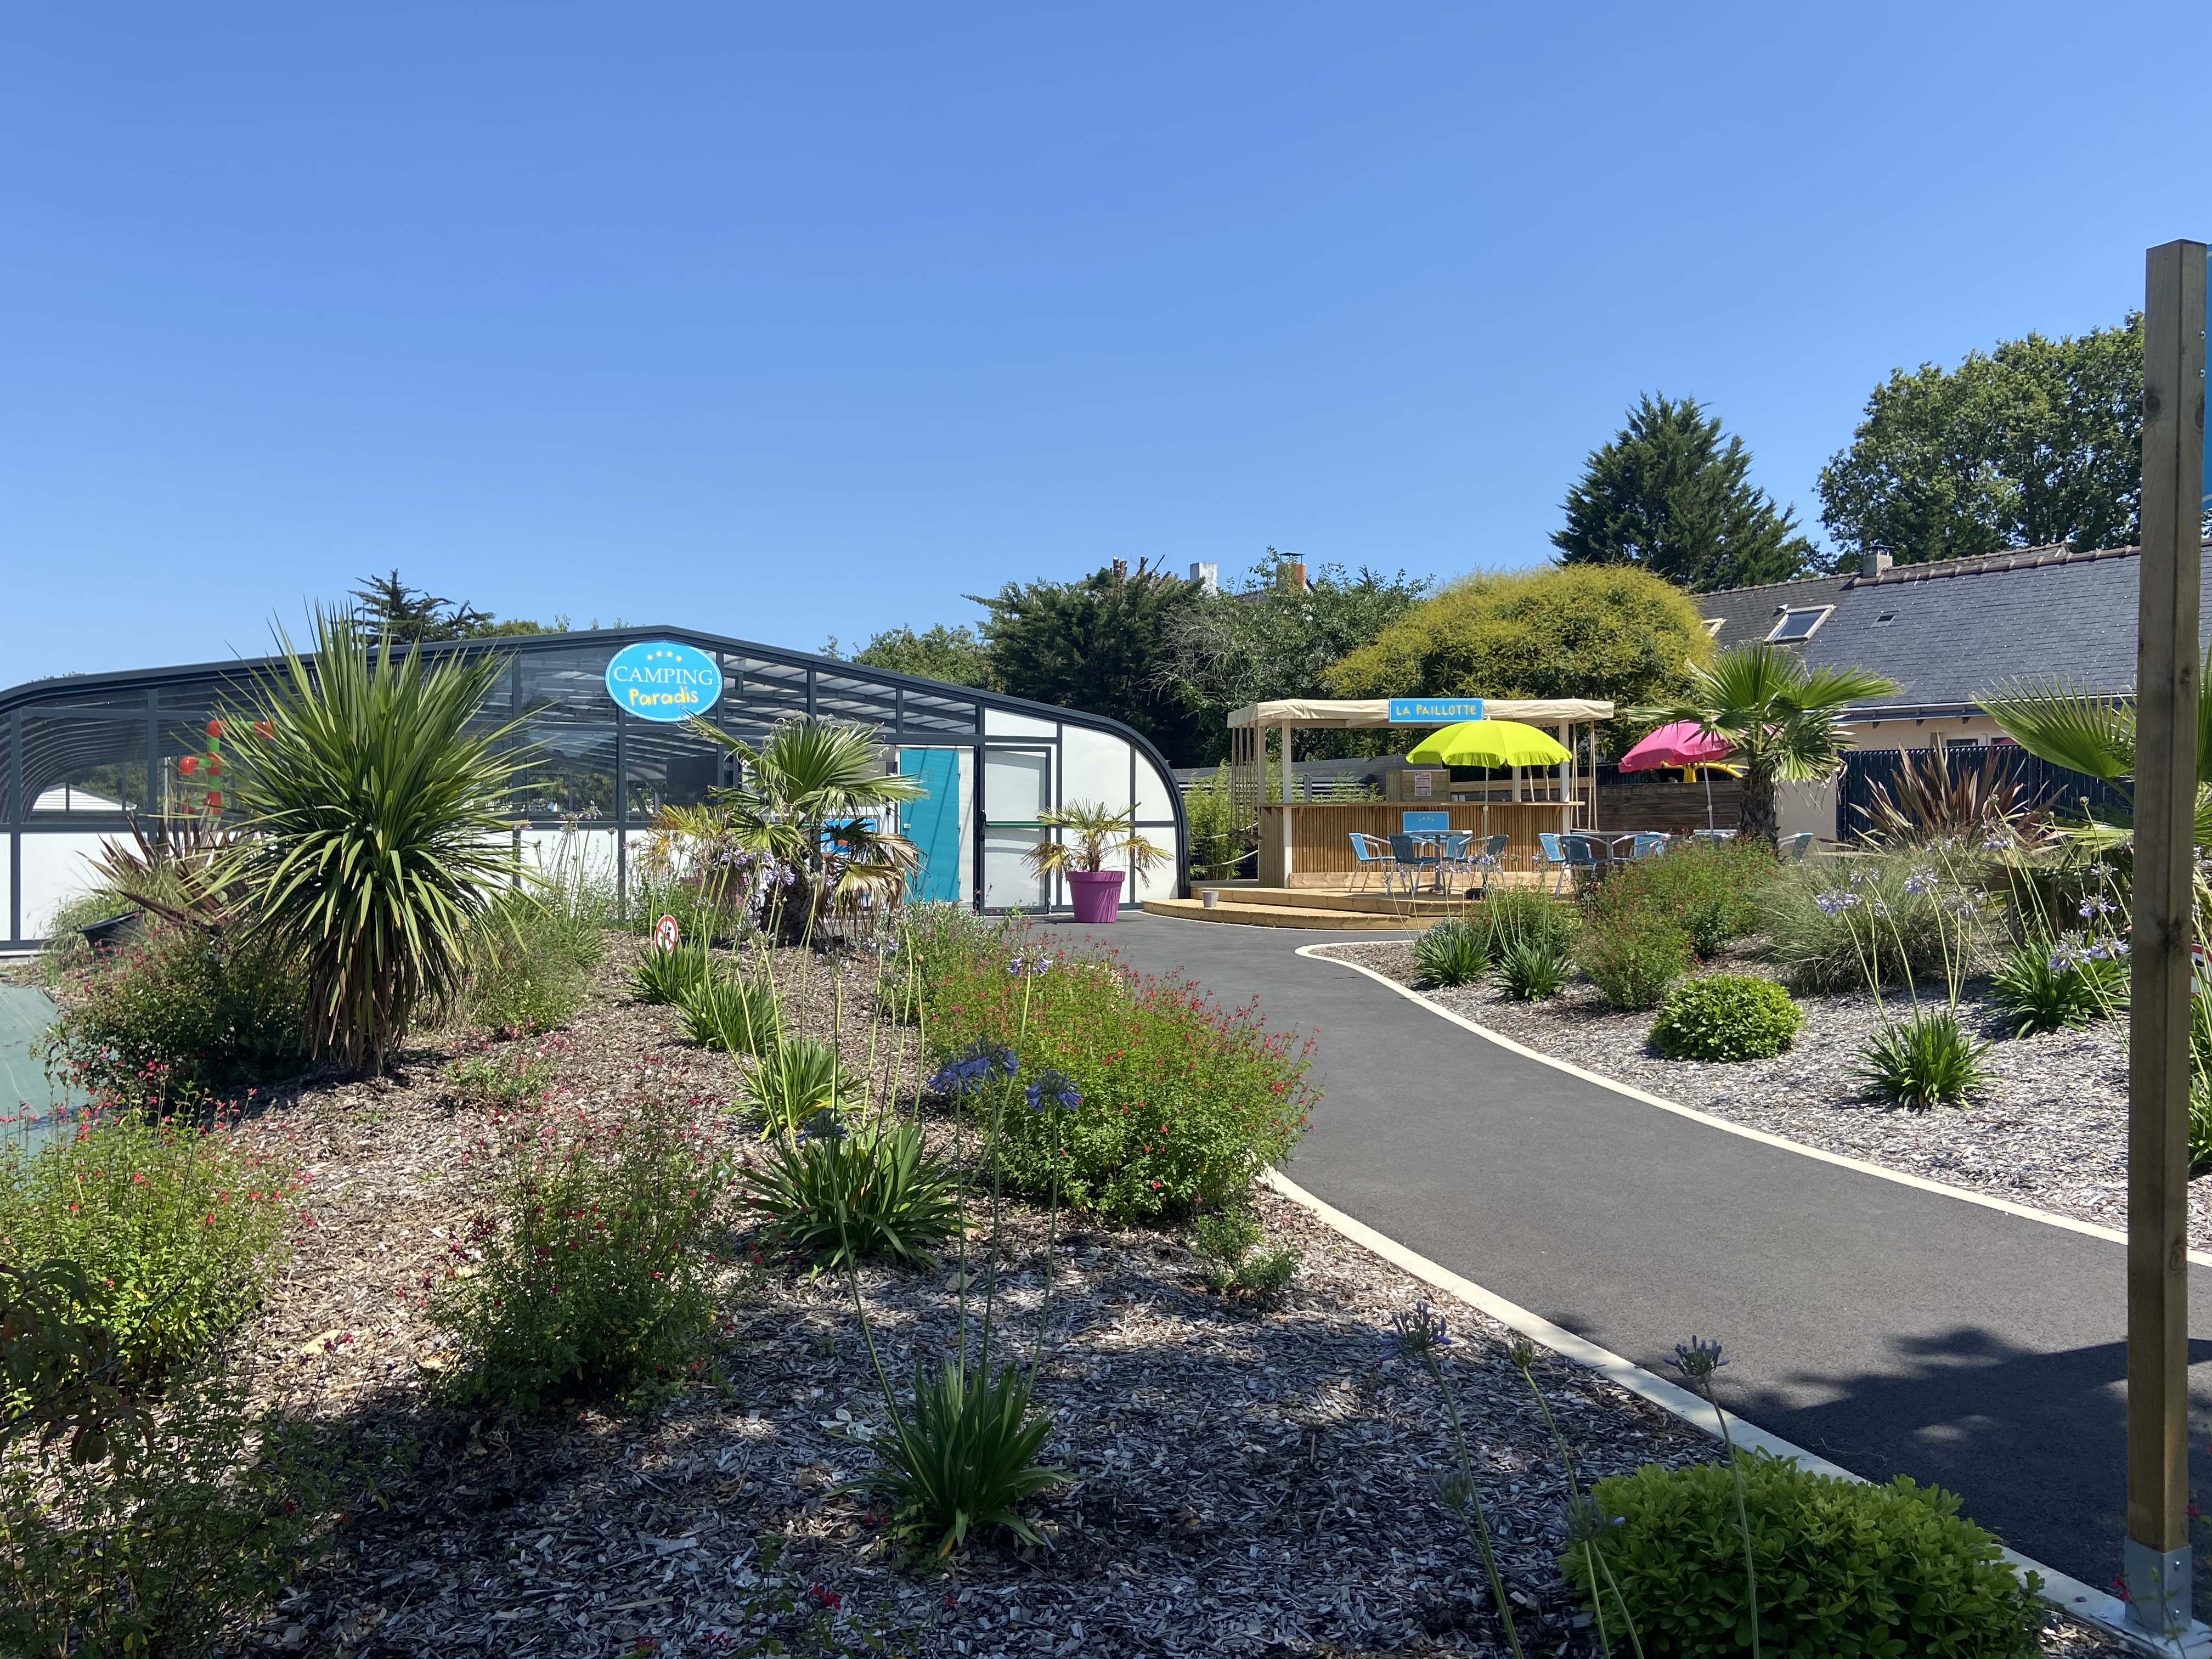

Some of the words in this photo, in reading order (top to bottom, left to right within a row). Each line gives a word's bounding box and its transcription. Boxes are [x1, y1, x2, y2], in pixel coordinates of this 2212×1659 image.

[613, 665, 713, 685] CAMPING
[629, 685, 698, 706] Paradis
[1396, 704, 1411, 715] LA
[1416, 704, 1476, 715] PAILLOTTE
